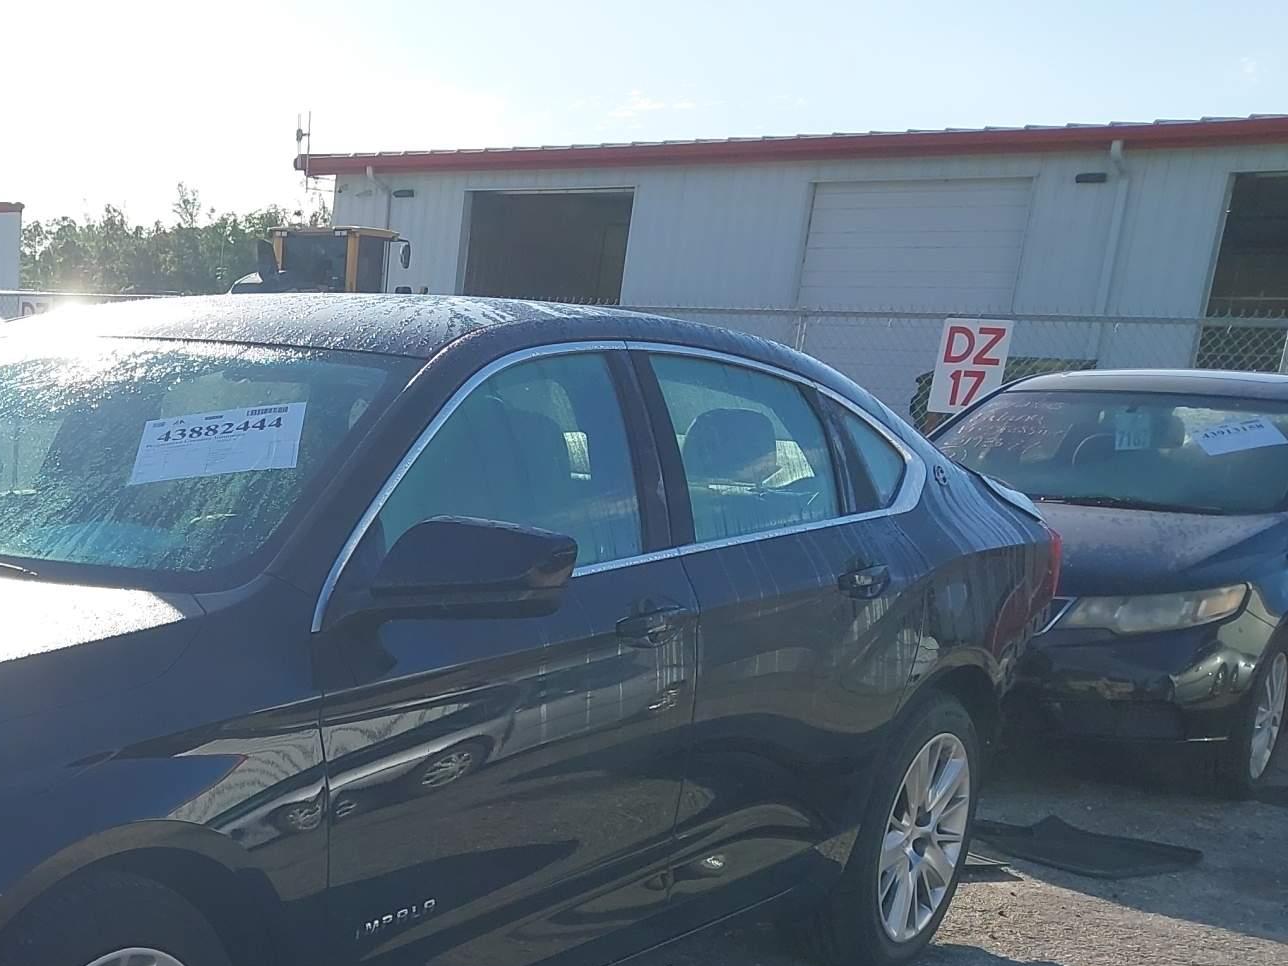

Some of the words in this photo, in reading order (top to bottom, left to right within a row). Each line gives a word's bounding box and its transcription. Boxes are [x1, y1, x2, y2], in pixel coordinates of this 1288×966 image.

[944, 326, 1006, 365] DZ
[949, 370, 985, 406] 17
[157, 416, 283, 442] 43882444
